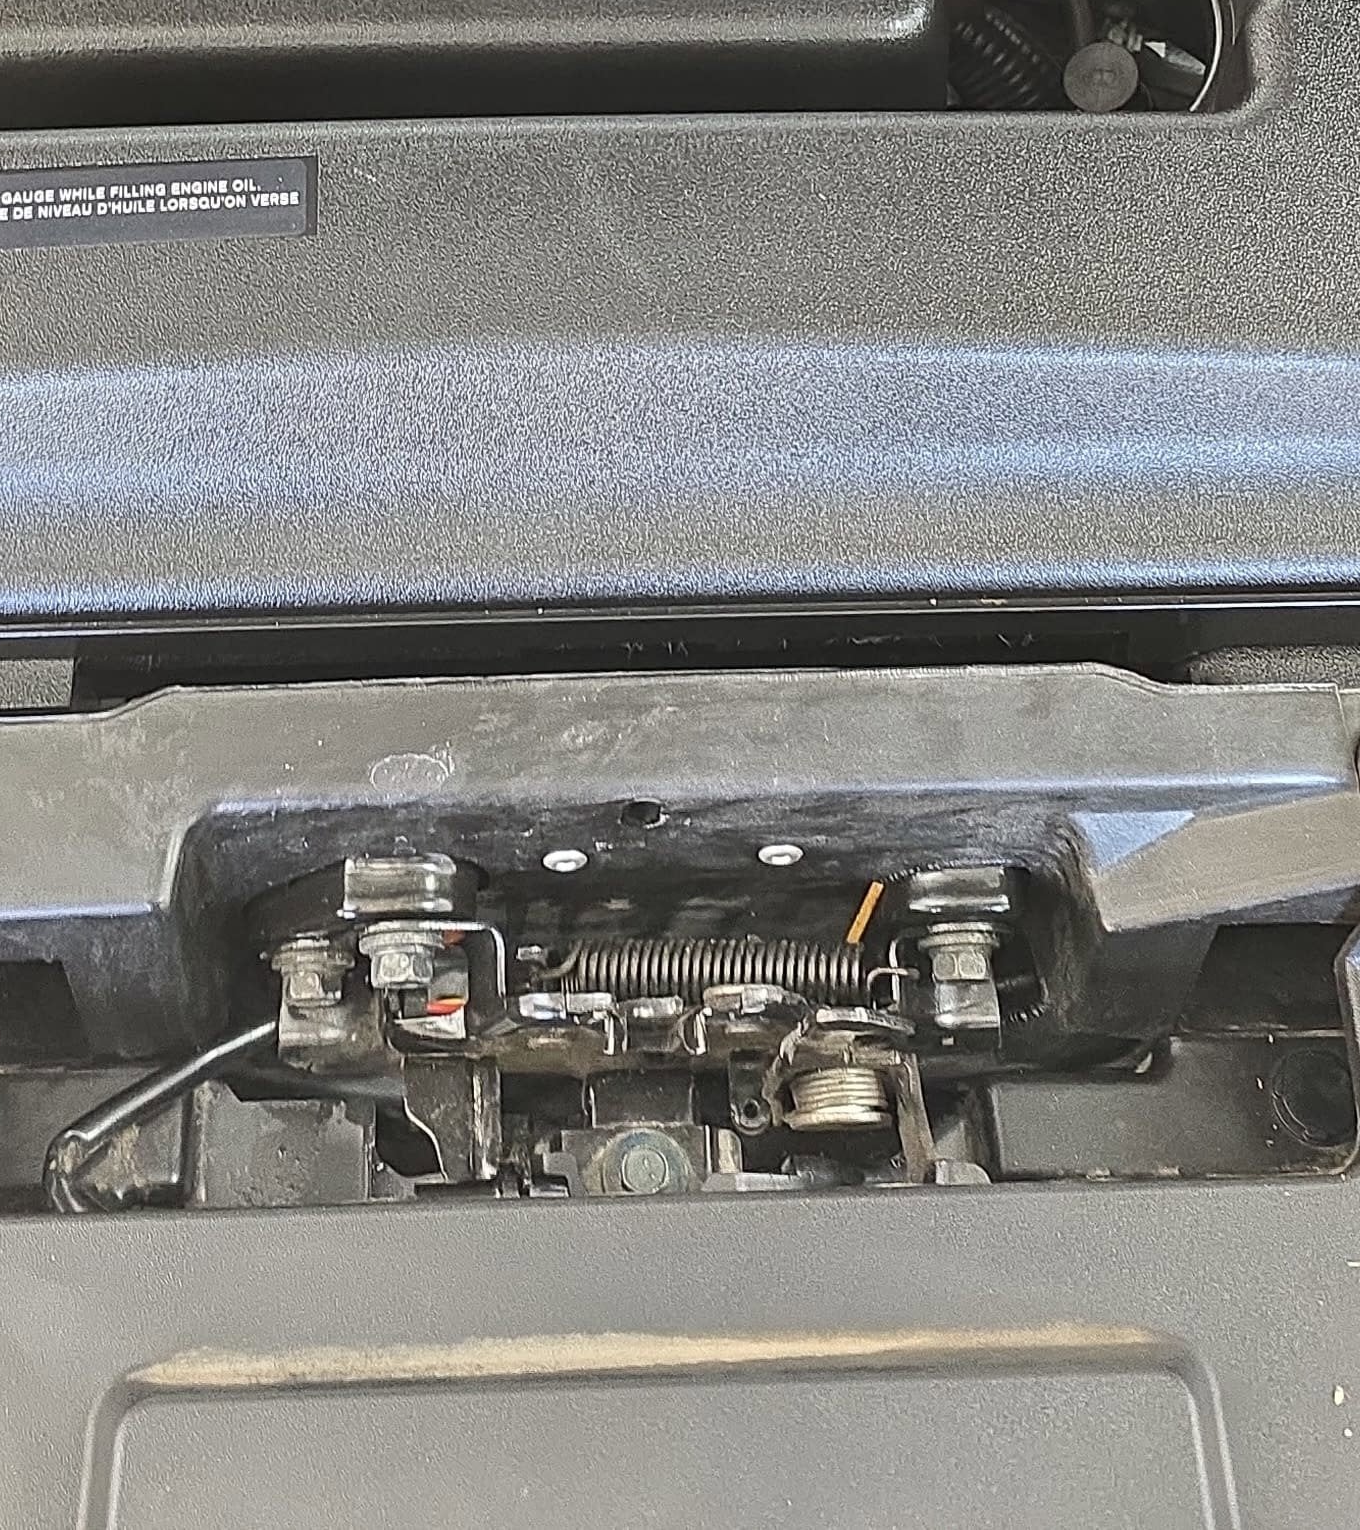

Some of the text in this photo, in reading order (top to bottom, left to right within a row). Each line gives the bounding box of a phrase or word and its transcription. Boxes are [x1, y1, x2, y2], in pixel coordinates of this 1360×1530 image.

[1, 190, 53, 205] GAUGE
[59, 187, 104, 202] WHILE
[110, 184, 165, 199] FILLING
[171, 180, 227, 196] ENGINE
[232, 179, 261, 192] OIL.
[13, 207, 32, 220] DE
[38, 204, 92, 219] NIVEAU
[98, 201, 154, 215] D'HUILE
[160, 196, 245, 212] LORSQU'ON
[250, 193, 299, 207] VERSE
